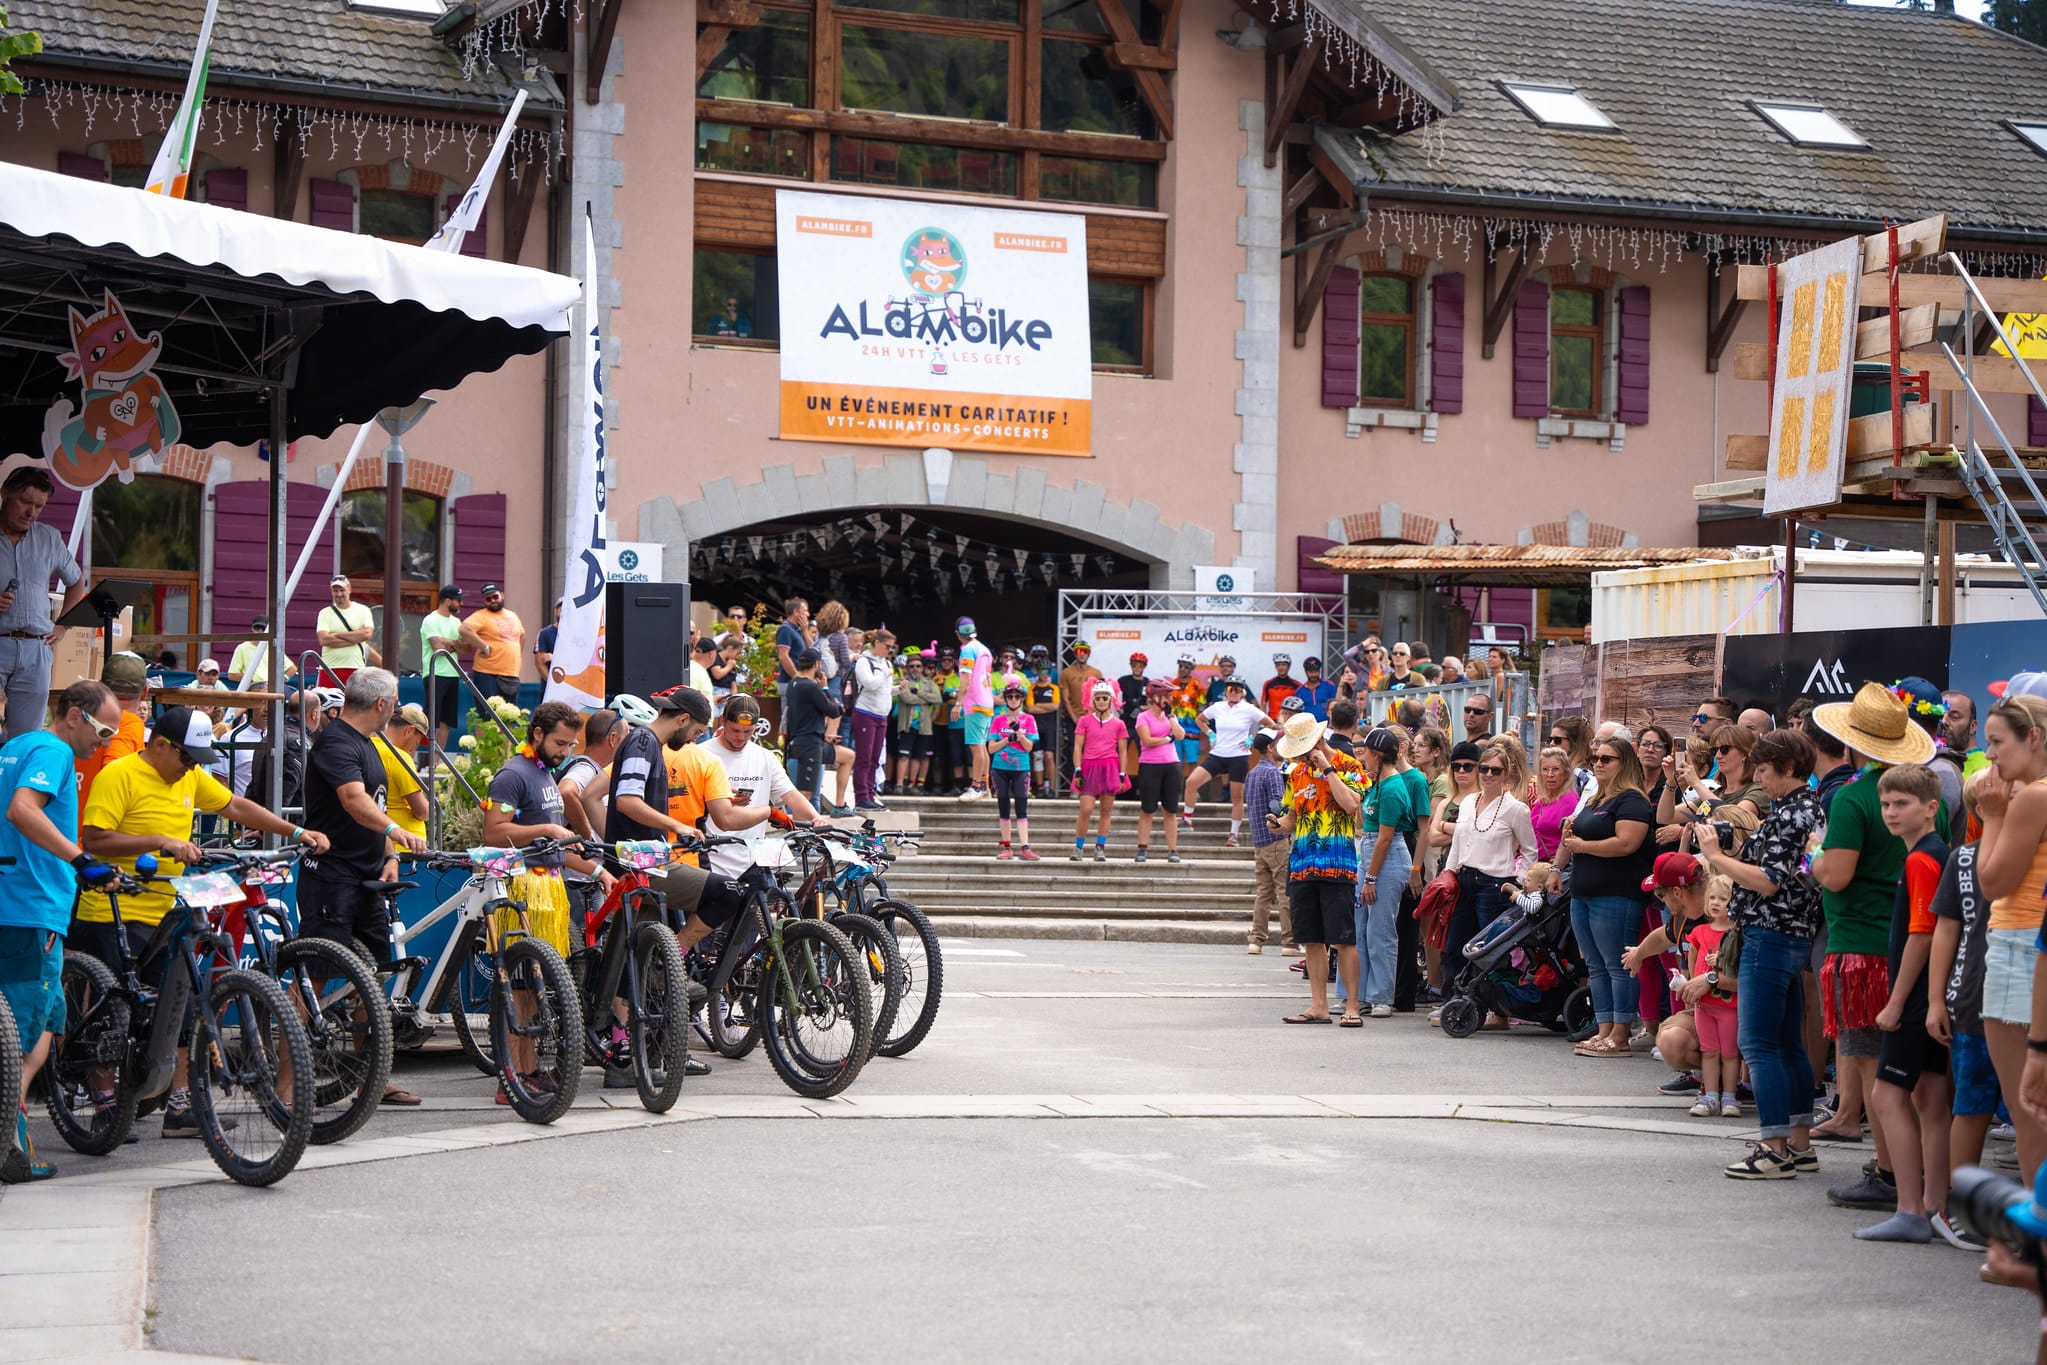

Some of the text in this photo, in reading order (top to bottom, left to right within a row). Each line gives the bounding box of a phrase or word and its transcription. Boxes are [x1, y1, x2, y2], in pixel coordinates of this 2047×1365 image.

[801, 220, 867, 233] ALAMBIKE.FR
[999, 236, 1063, 249] ALAMBIKE.FR
[861, 344, 1021, 366] 24H VTT LES GETS
[806, 395, 831, 411] UN
[960, 405, 1056, 424] CARITATIF
[607, 571, 649, 582] Les Gets
[1958, 846, 1976, 868] OK
[1958, 869, 1974, 894] BE
[1962, 897, 1976, 922] TO
